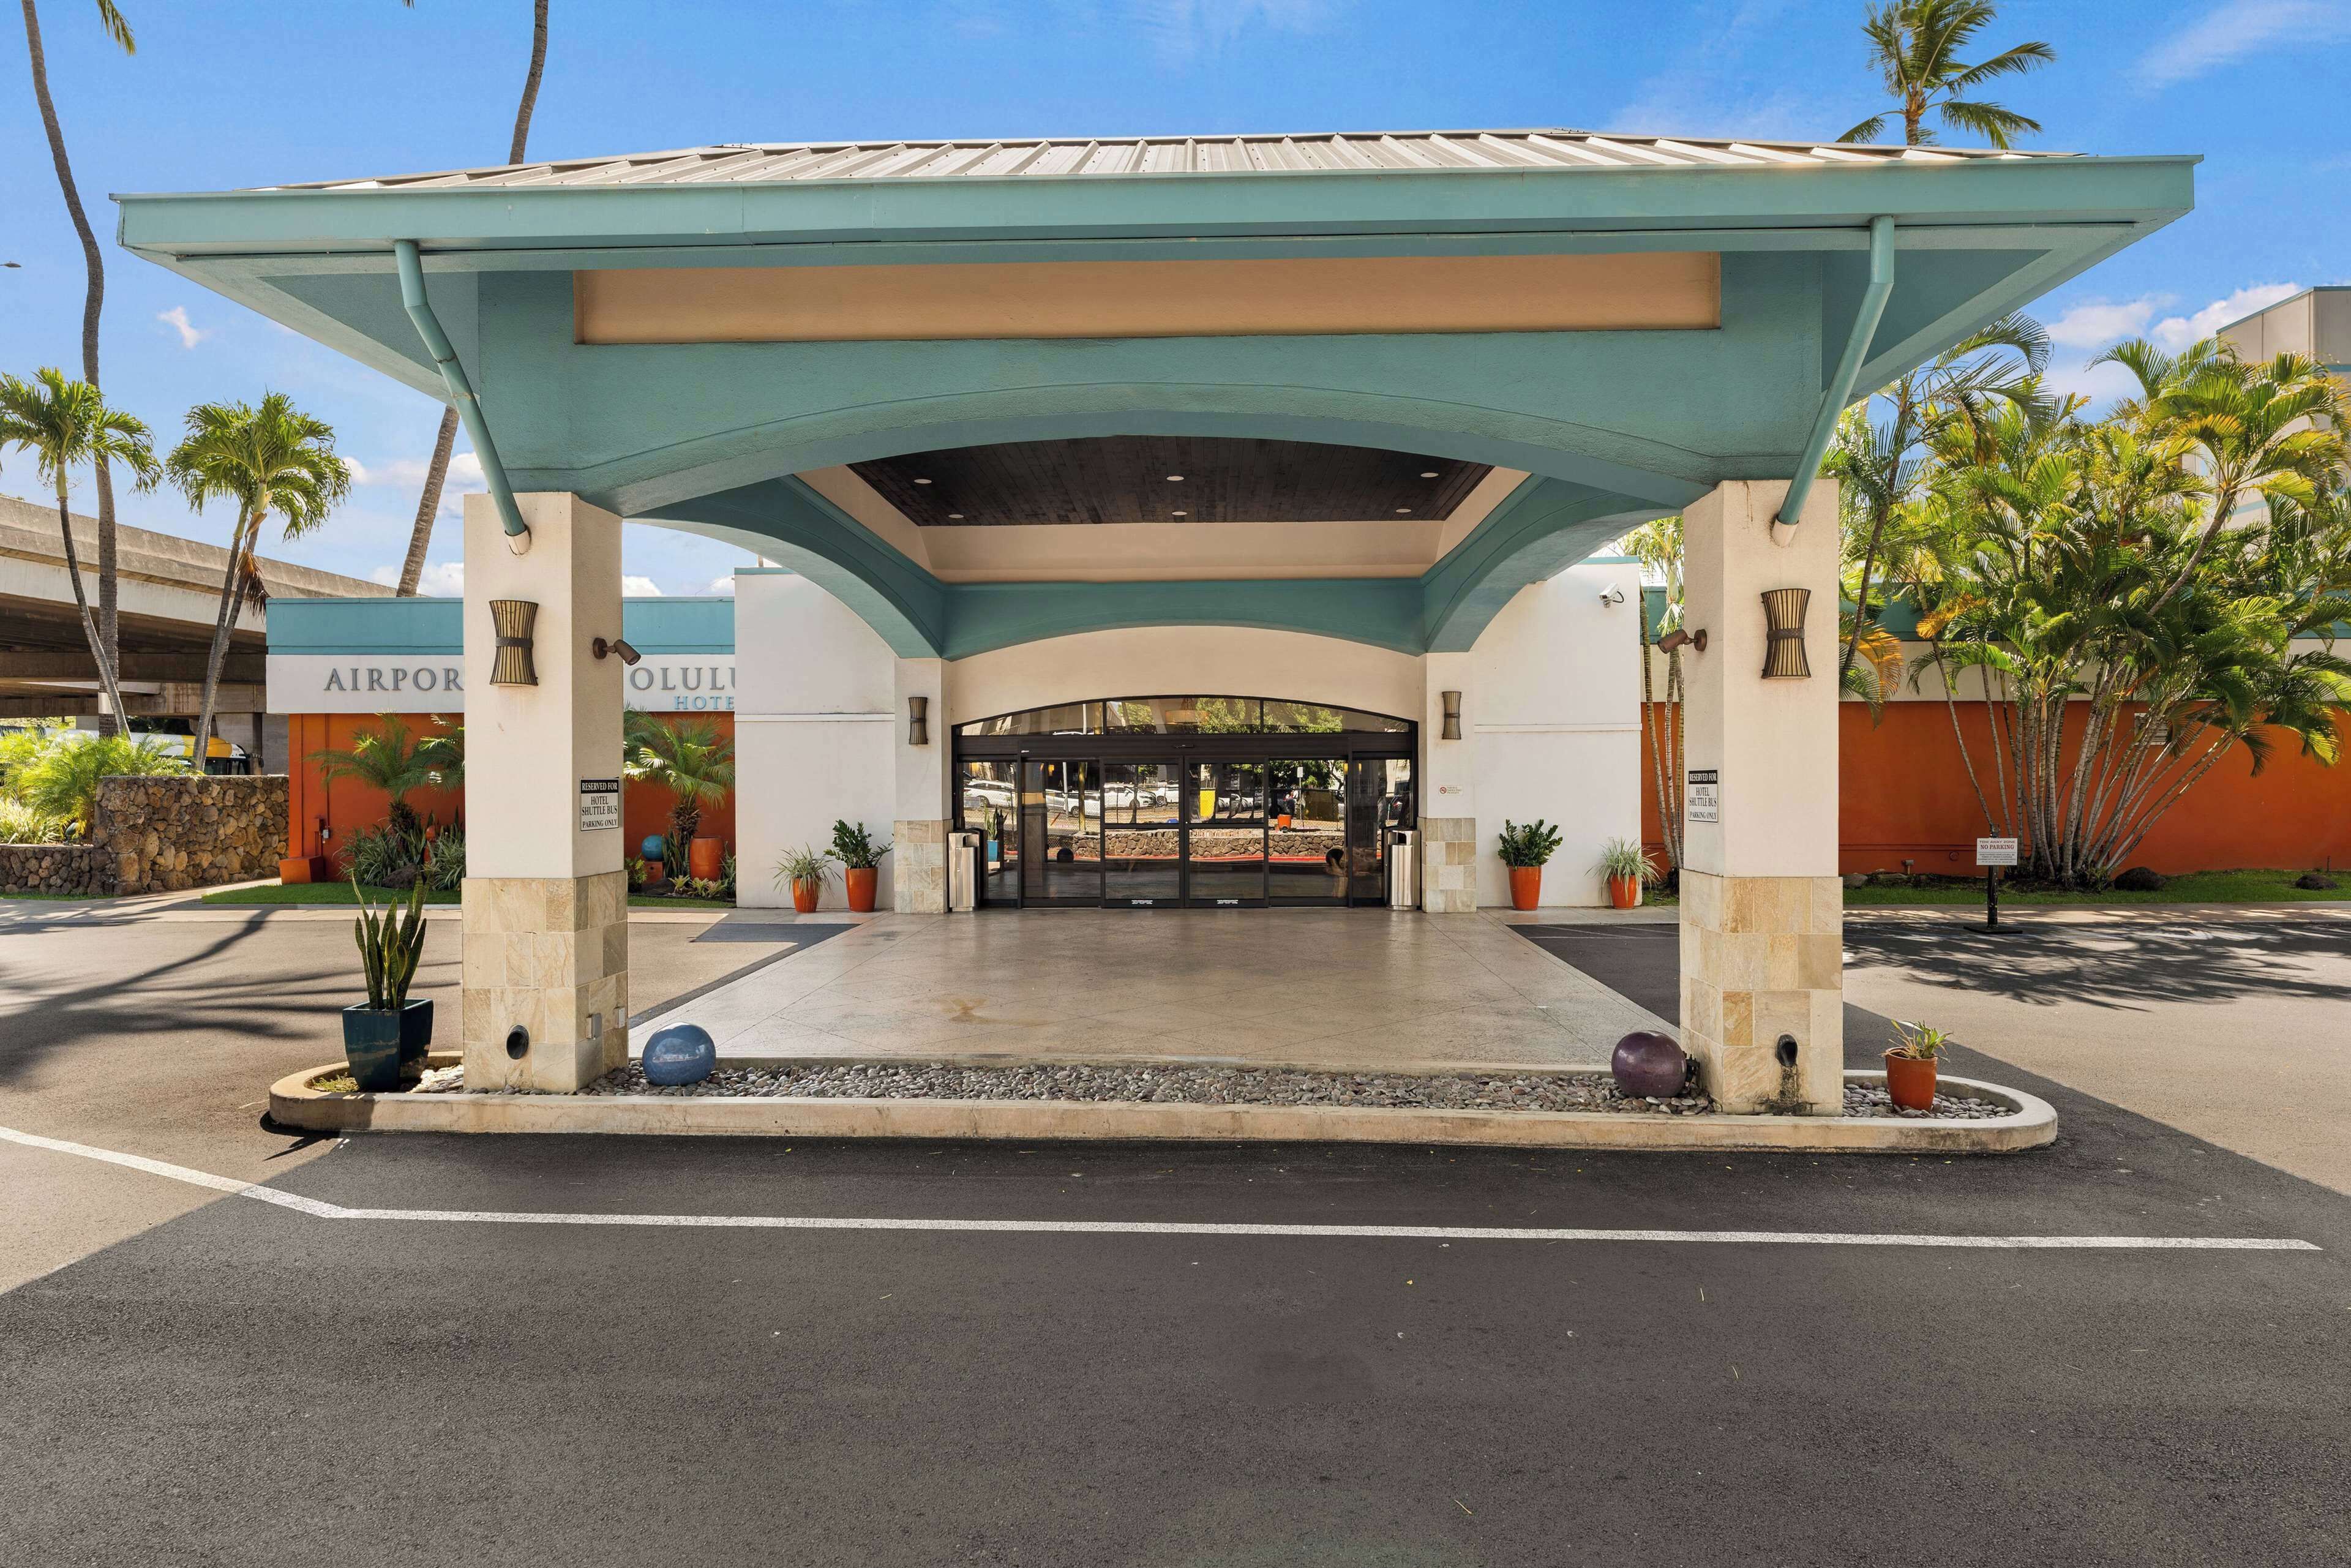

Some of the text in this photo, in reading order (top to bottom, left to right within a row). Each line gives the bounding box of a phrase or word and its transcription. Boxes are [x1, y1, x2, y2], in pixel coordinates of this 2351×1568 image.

[323, 668, 464, 691] AIRPOR
[674, 696, 734, 710] HOTE
[1696, 787, 1709, 796] HOTEL
[591, 796, 609, 805] HOTEL
[1689, 797, 1717, 807] SHUTTLE BUS
[582, 805, 617, 816] SHUTTLE BUS
